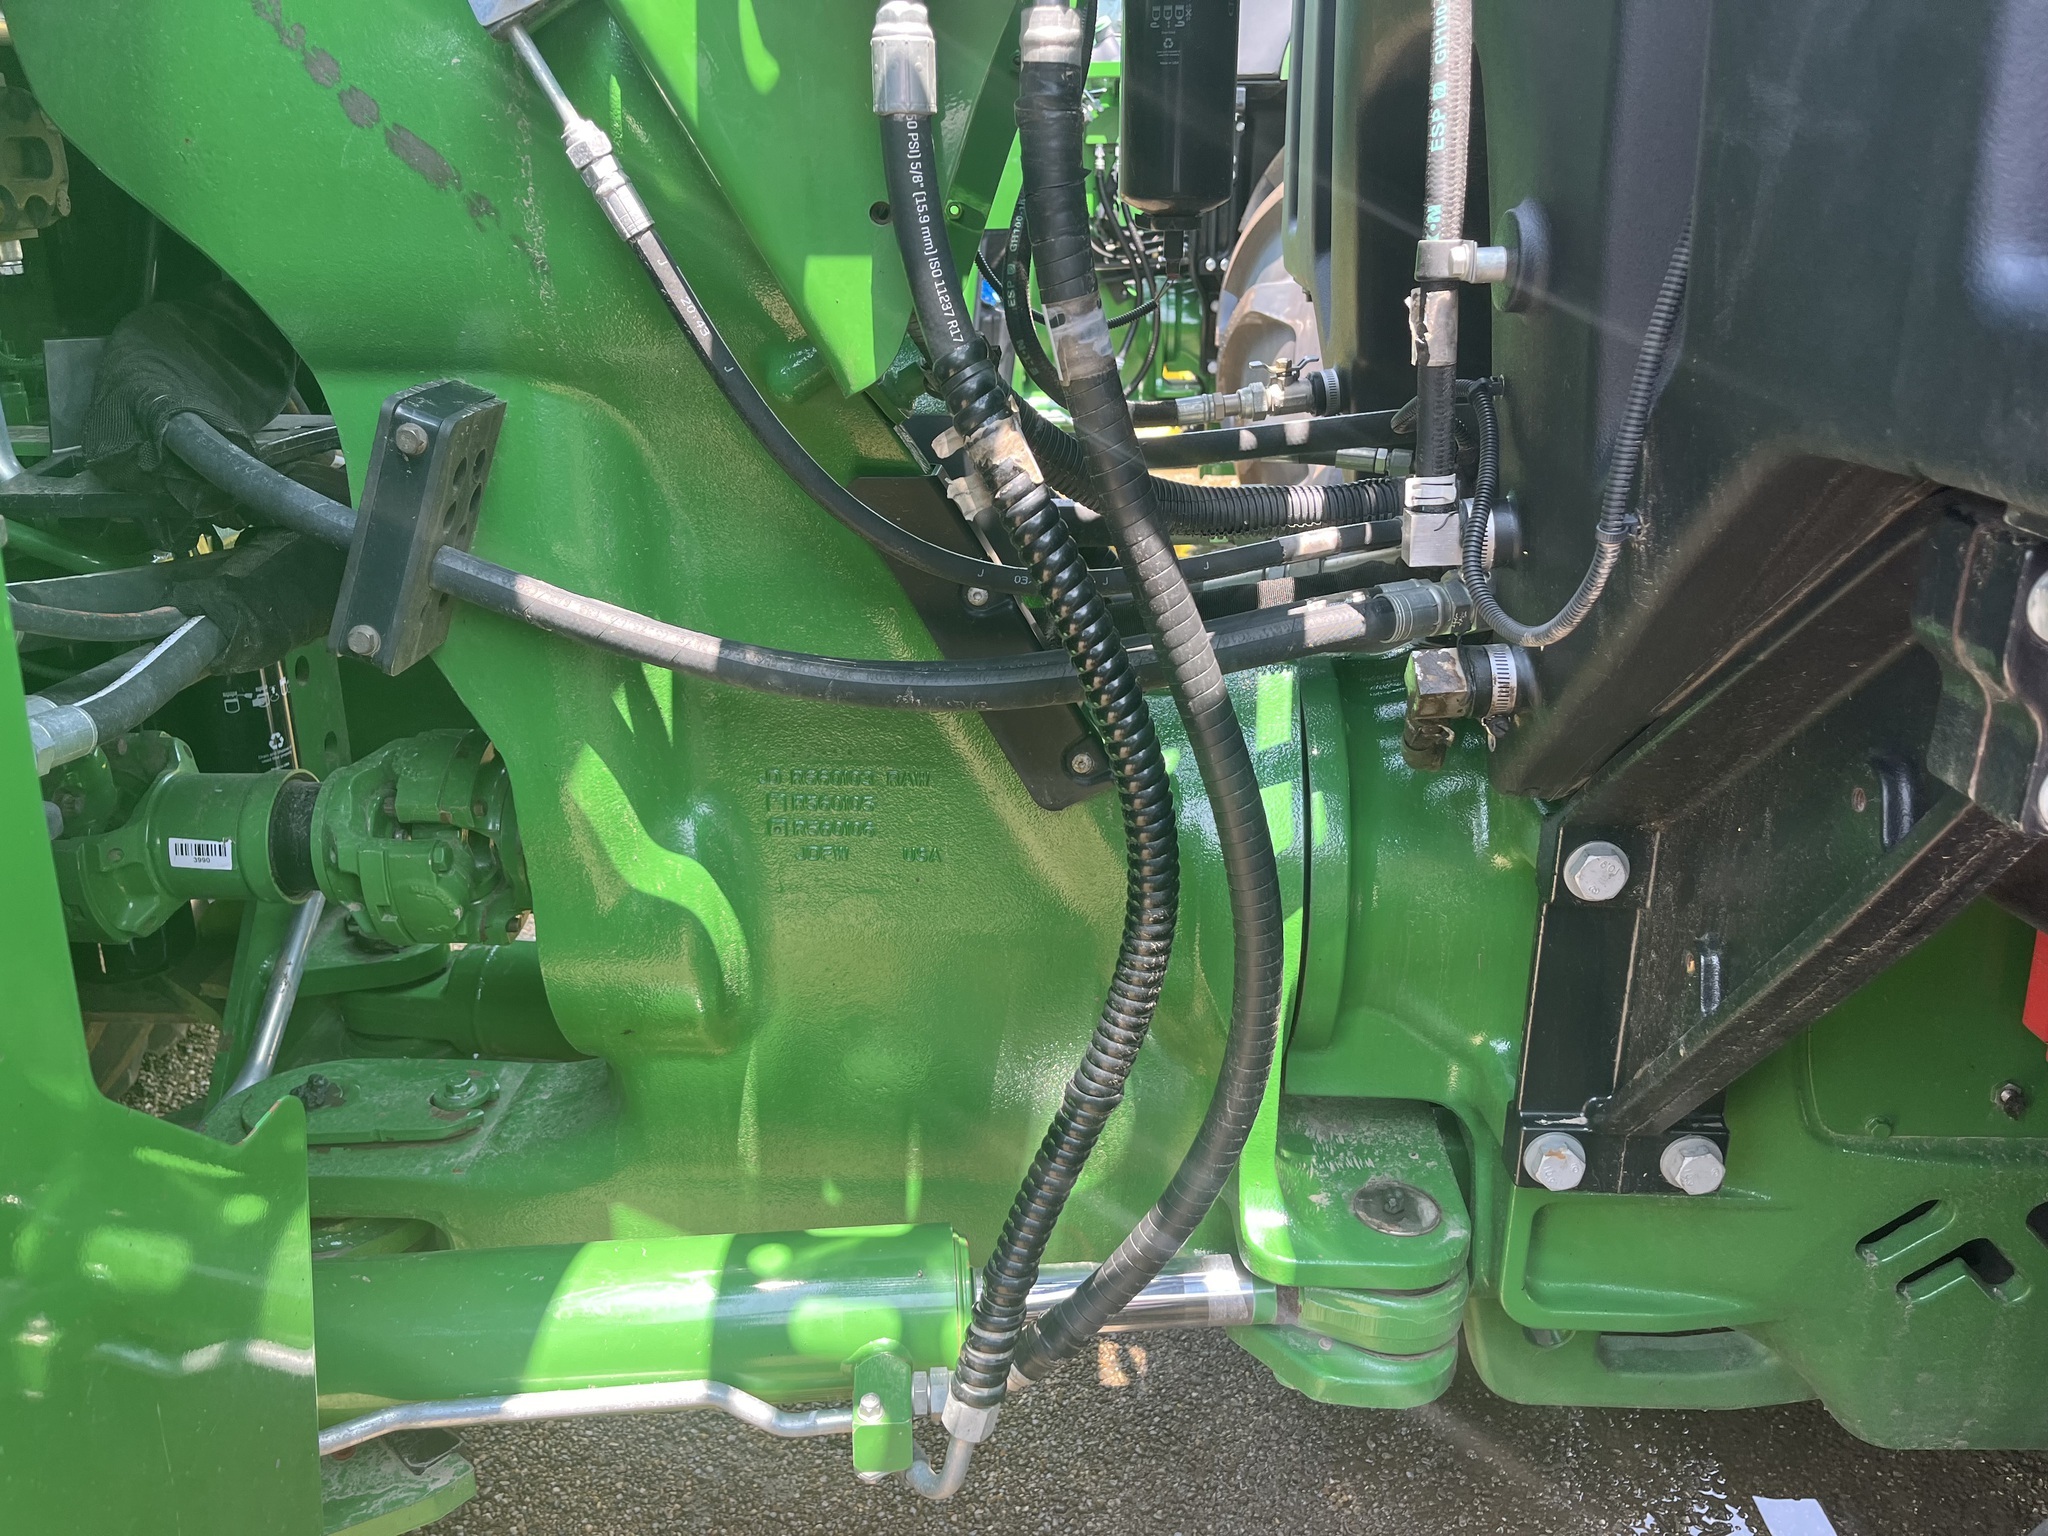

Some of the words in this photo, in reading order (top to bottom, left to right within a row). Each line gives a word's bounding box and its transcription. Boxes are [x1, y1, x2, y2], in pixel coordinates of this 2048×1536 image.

[1431, 108, 1446, 152] ESP
[907, 132, 921, 159] PSI)
[909, 161, 924, 188] 5/8"
[912, 191, 930, 224] (15.9
[920, 226, 938, 256] mm)
[928, 257, 943, 278] ISO
[934, 280, 956, 318] 11237
[1007, 281, 1017, 307] ESP
[947, 320, 964, 343] R17
[758, 768, 782, 786] JD
[886, 769, 931, 787] RAW
[902, 846, 942, 863] USA
